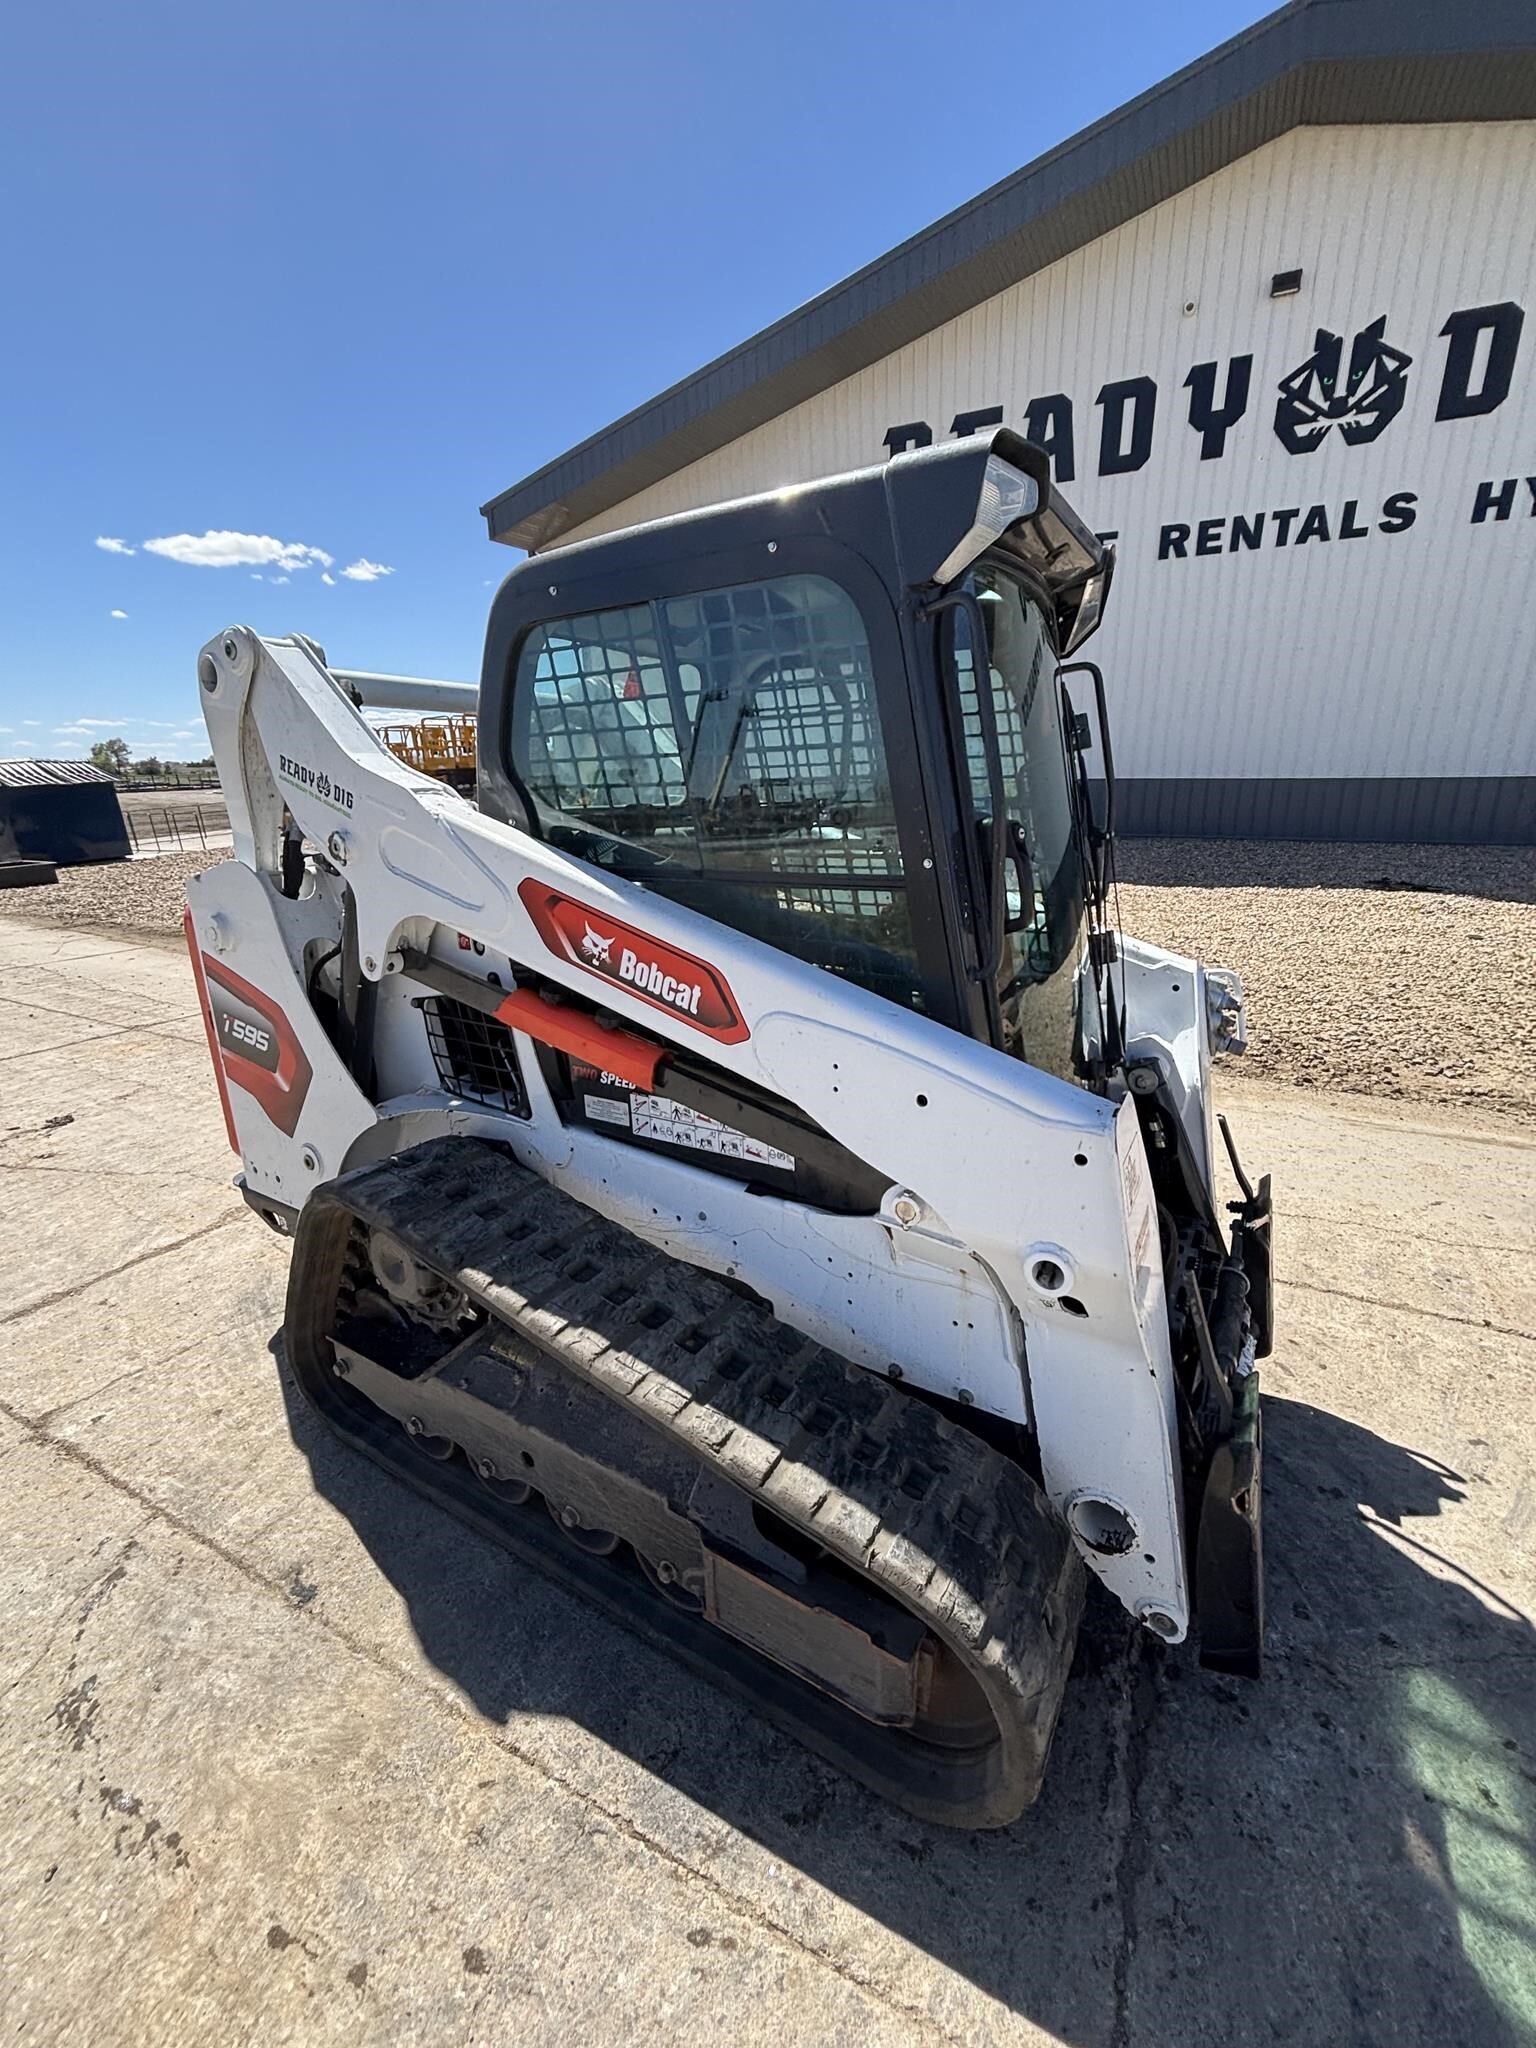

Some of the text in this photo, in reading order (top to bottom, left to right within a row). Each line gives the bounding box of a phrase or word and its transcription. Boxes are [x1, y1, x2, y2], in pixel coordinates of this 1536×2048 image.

[1157, 476, 1536, 561] RENTALS H
[279, 754, 315, 788] READY
[333, 784, 354, 810] DIG
[619, 947, 702, 1016] Bobcat
